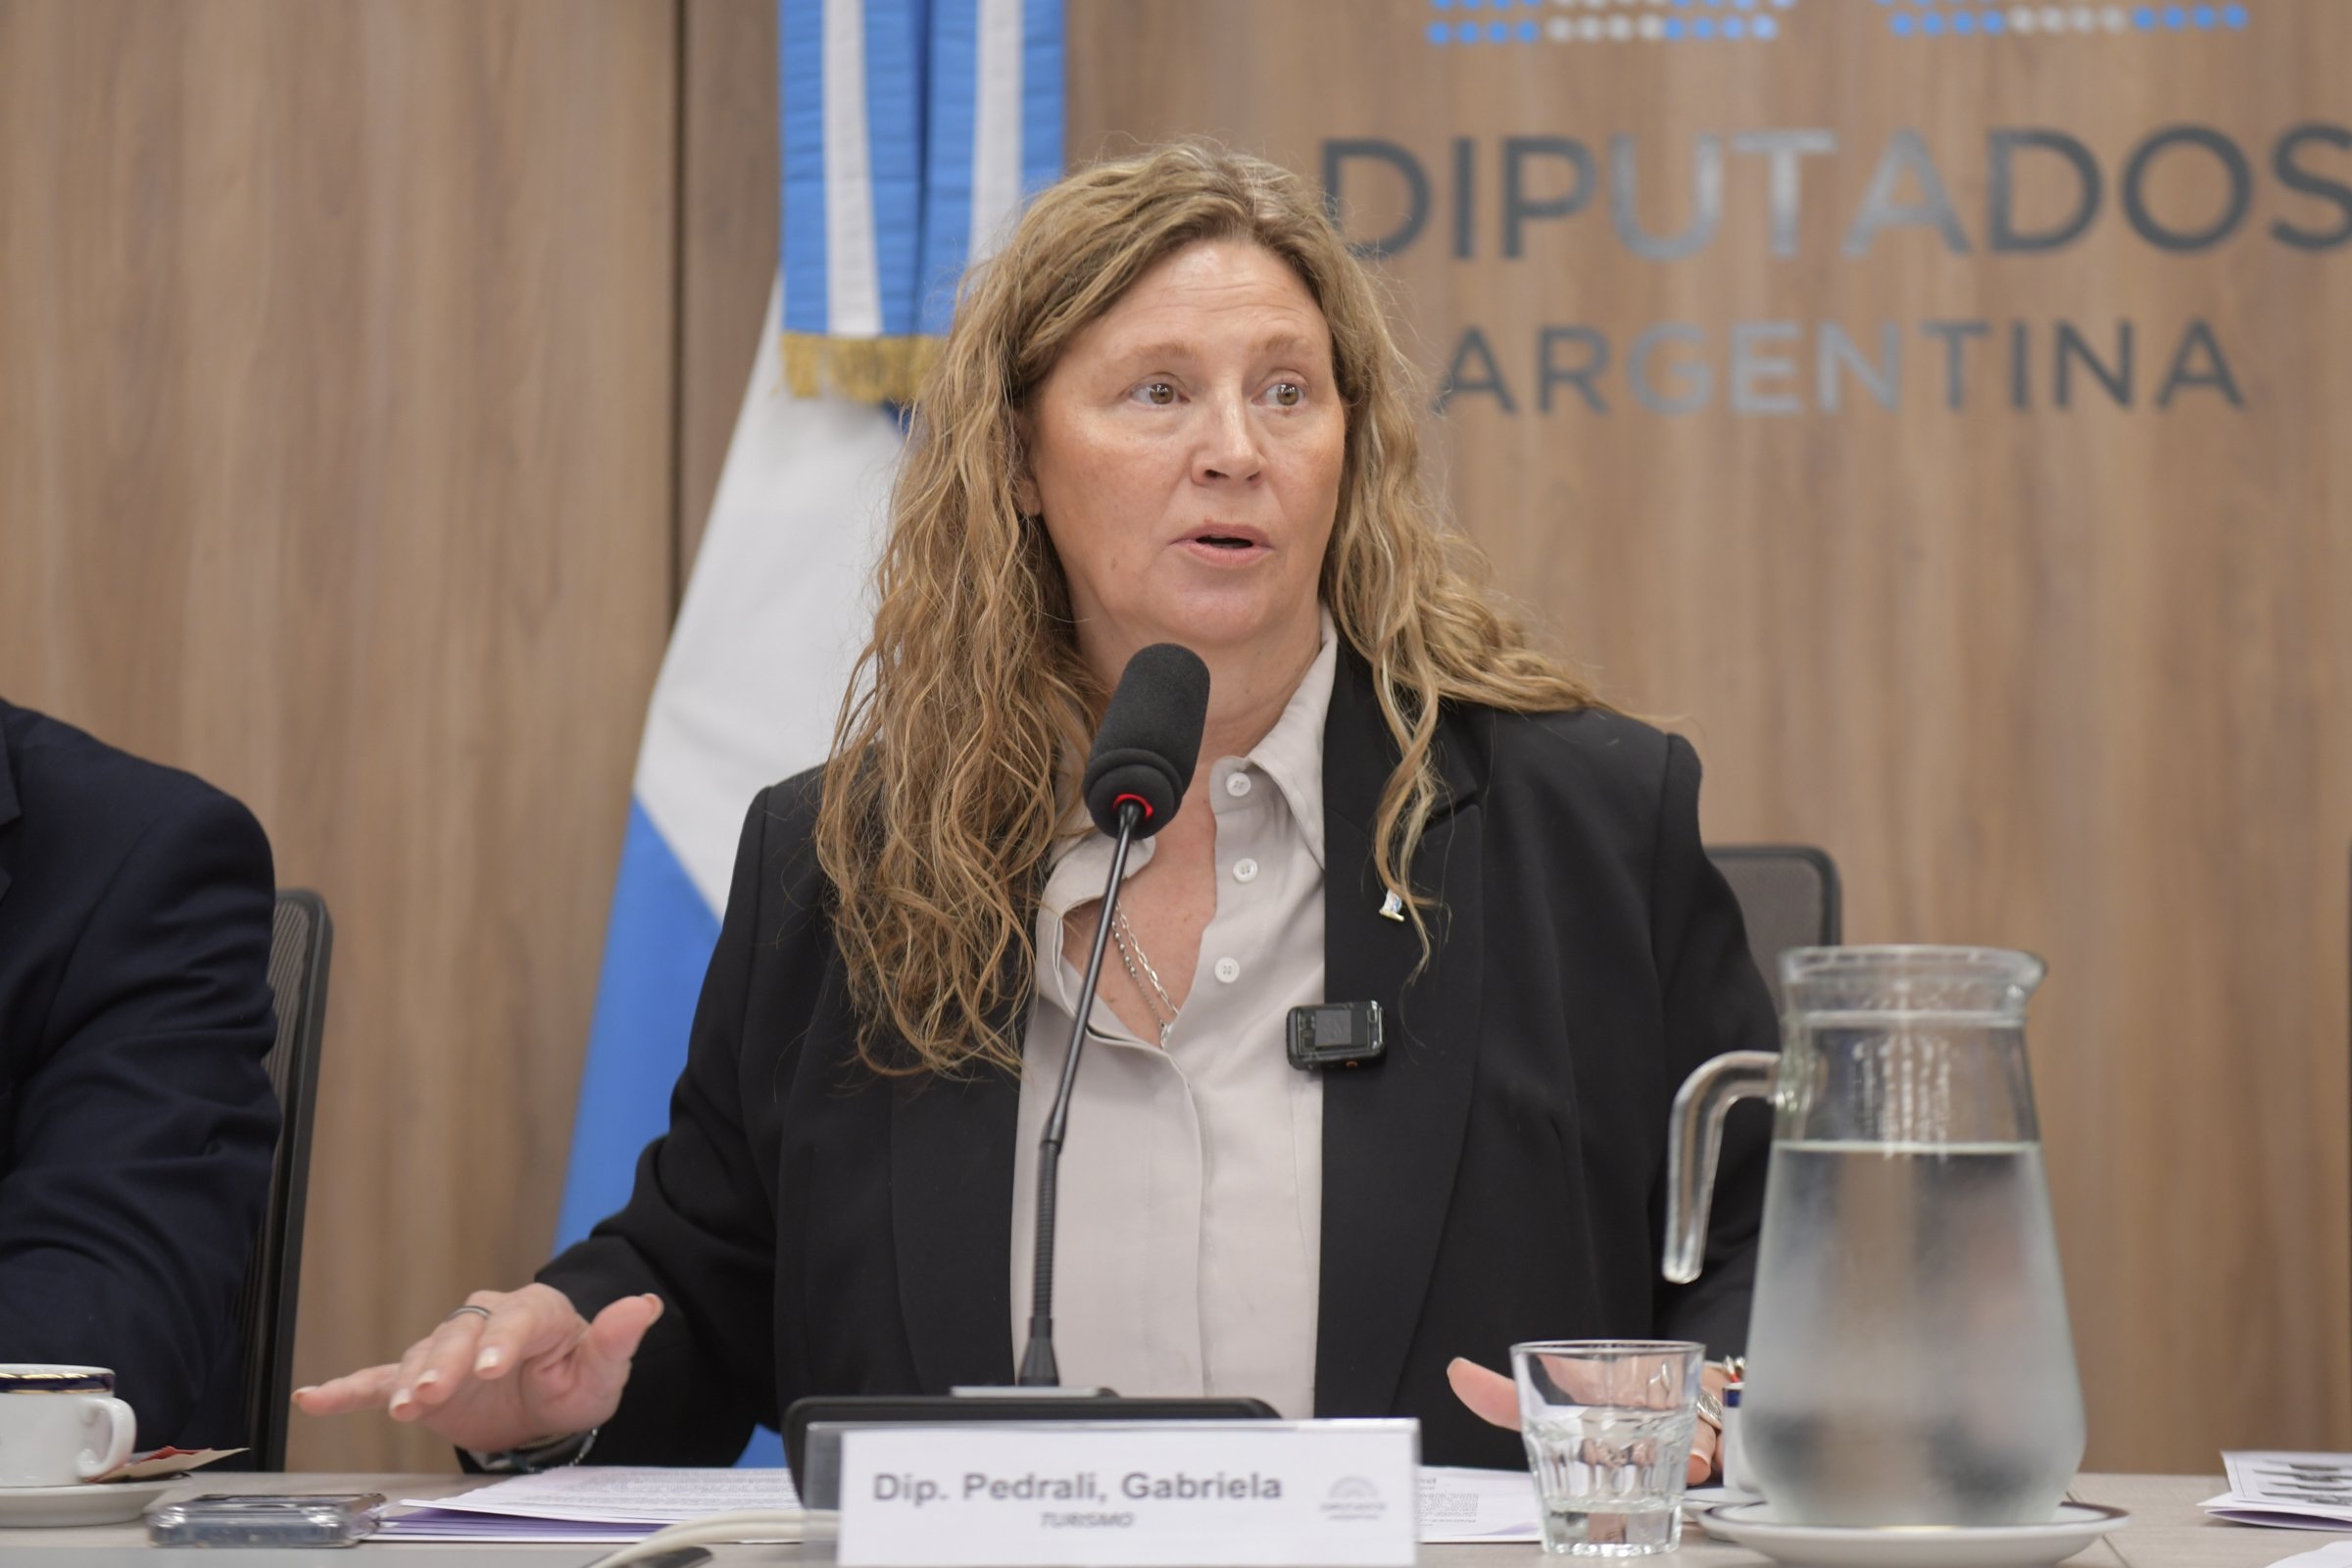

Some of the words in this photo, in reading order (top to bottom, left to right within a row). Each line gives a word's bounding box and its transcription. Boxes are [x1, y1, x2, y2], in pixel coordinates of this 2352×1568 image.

[1322, 126, 2352, 259] DIPUTADOS
[1431, 319, 2245, 416] ARGENTINA
[873, 1472, 949, 1506] Dip.
[962, 1472, 1107, 1503] Pedrali,
[1122, 1472, 1282, 1500] Gabriela
[1040, 1511, 1135, 1529] TURISMO
